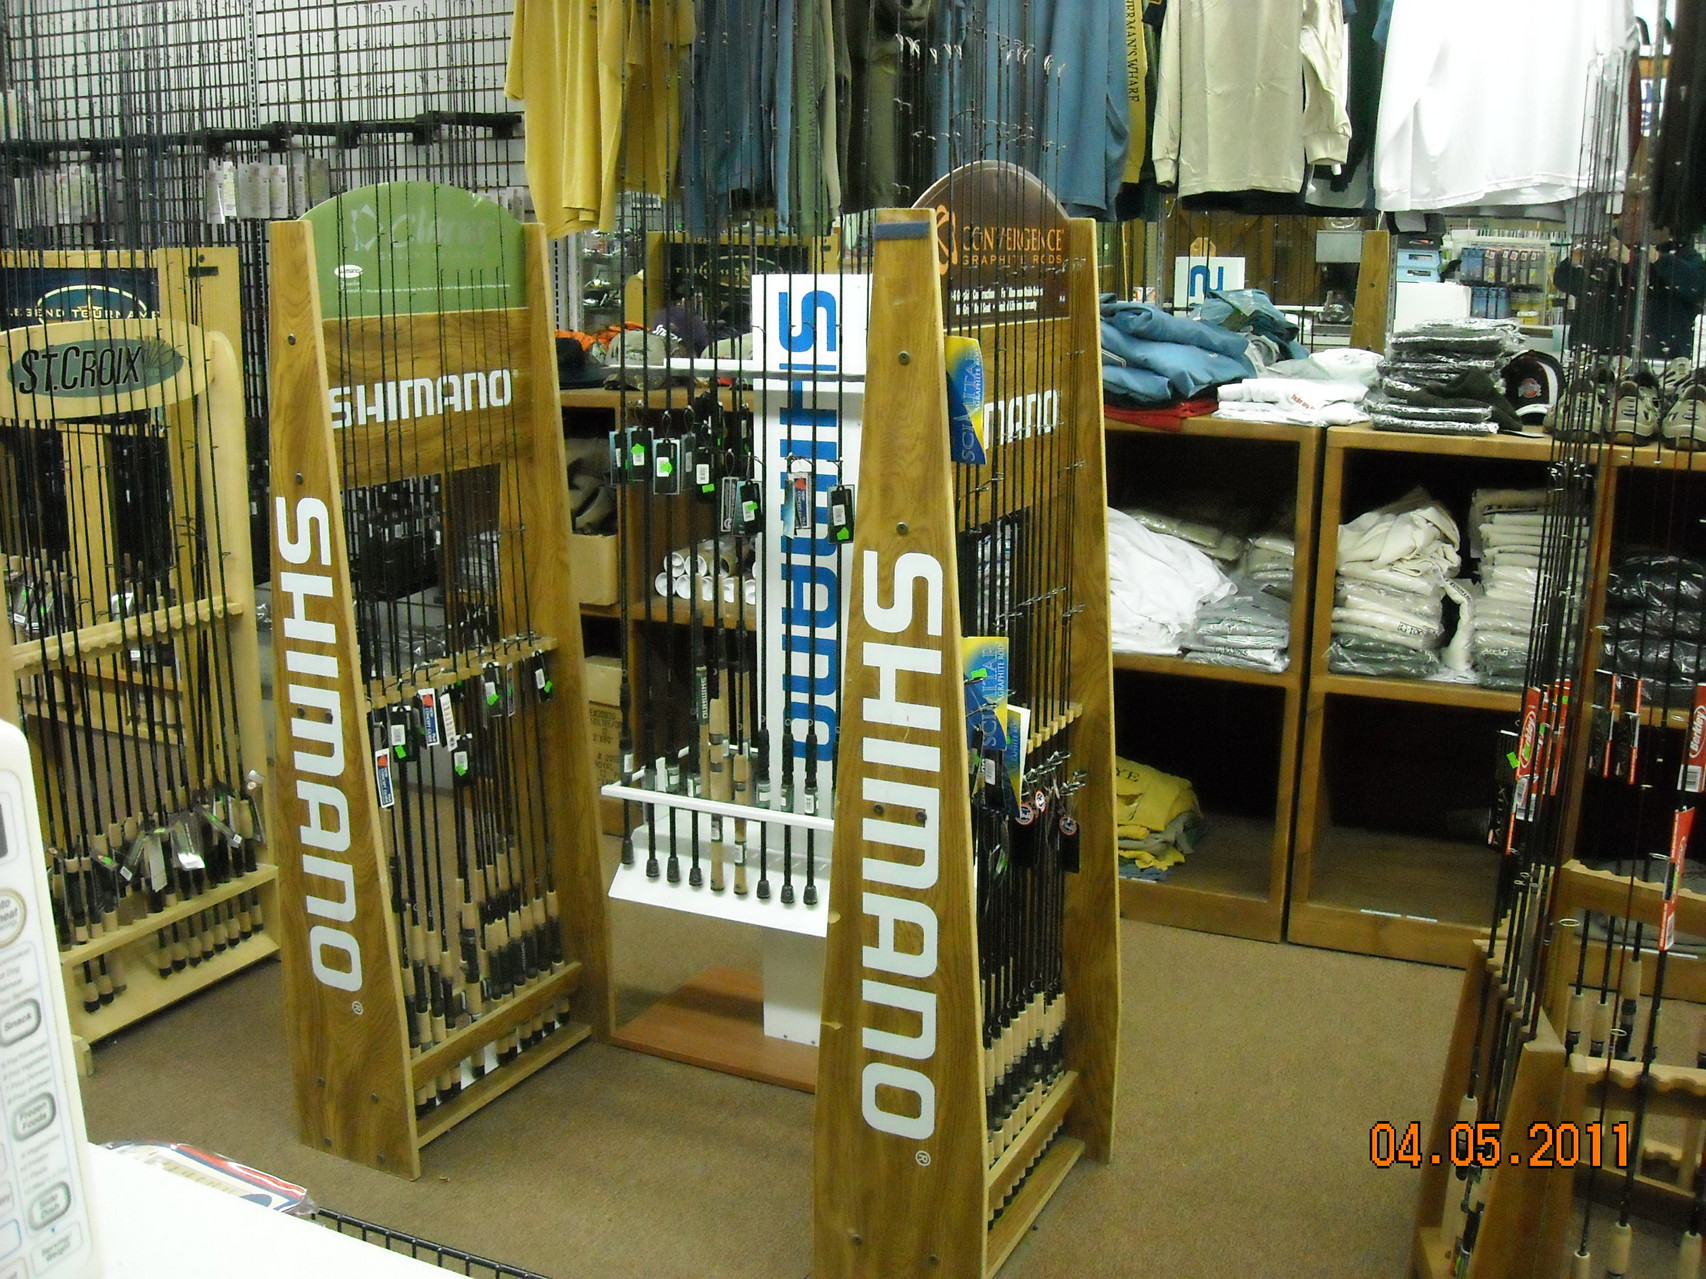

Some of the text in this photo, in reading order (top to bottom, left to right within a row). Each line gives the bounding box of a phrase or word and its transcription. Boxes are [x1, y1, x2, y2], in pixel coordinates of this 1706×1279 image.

[1128, 58, 1140, 103] WHARF
[963, 226, 1062, 252] CONVERGENCE
[8, 307, 65, 319] EGEND
[329, 369, 512, 429] SHIMANO
[778, 290, 838, 762] SHIMANO
[701, 677, 709, 719] SHIMANO
[996, 661, 1005, 698] GRAPHITE
[275, 496, 363, 991] SHIMANO
[1689, 709, 1706, 753] Berkley
[862, 551, 943, 1140] SHIMANO
[4, 1010, 33, 1032] Snack
[20, 1101, 47, 1121] Frozen
[22, 1112, 47, 1131] Foods
